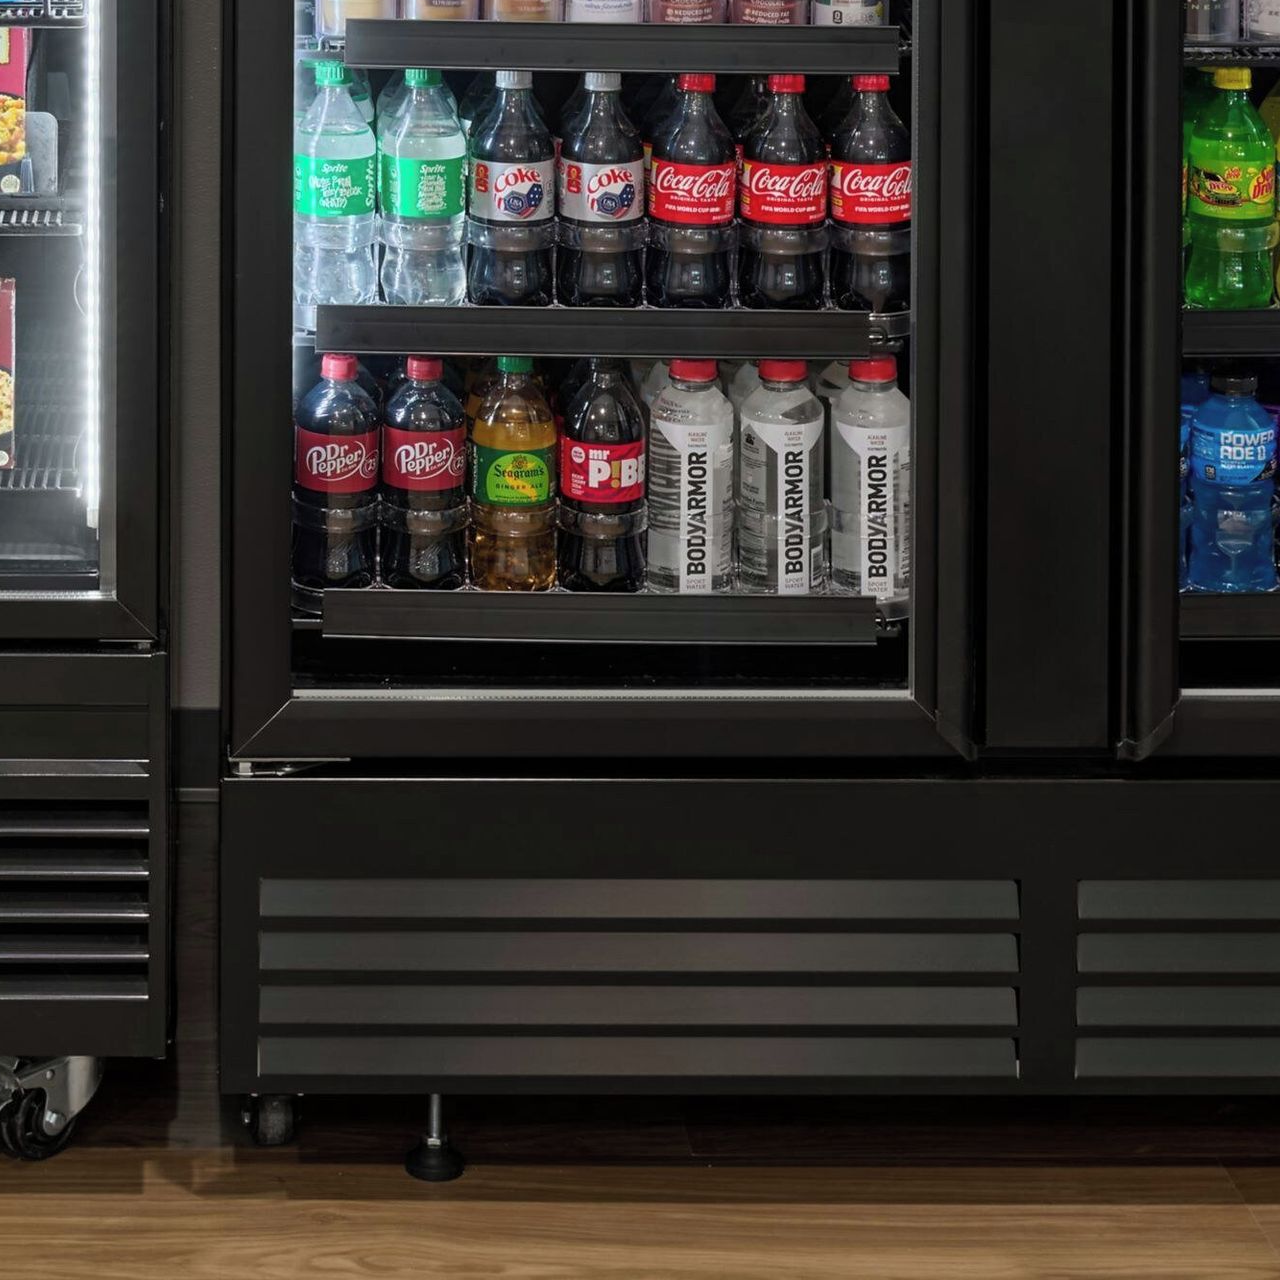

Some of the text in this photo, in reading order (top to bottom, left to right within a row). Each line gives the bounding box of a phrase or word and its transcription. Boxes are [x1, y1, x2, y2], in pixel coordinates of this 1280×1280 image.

[322, 163, 348, 173] Sprite
[656, 166, 732, 198] Coca-Cola
[752, 167, 826, 198] Coca-Cola
[665, 204, 678, 212] FIFA
[679, 205, 697, 213] WORLD
[1220, 430, 1275, 446] POWER
[311, 446, 362, 475] Pepper
[326, 443, 348, 458] Dr
[399, 445, 450, 474] Pepper
[414, 442, 437, 458] Dr
[1220, 445, 1254, 460] ADE
[494, 463, 545, 480] Seagram's
[686, 451, 708, 576] BODYARMOR
[785, 450, 804, 576] BODYARMOR
[867, 454, 887, 578] BODYARMOR
